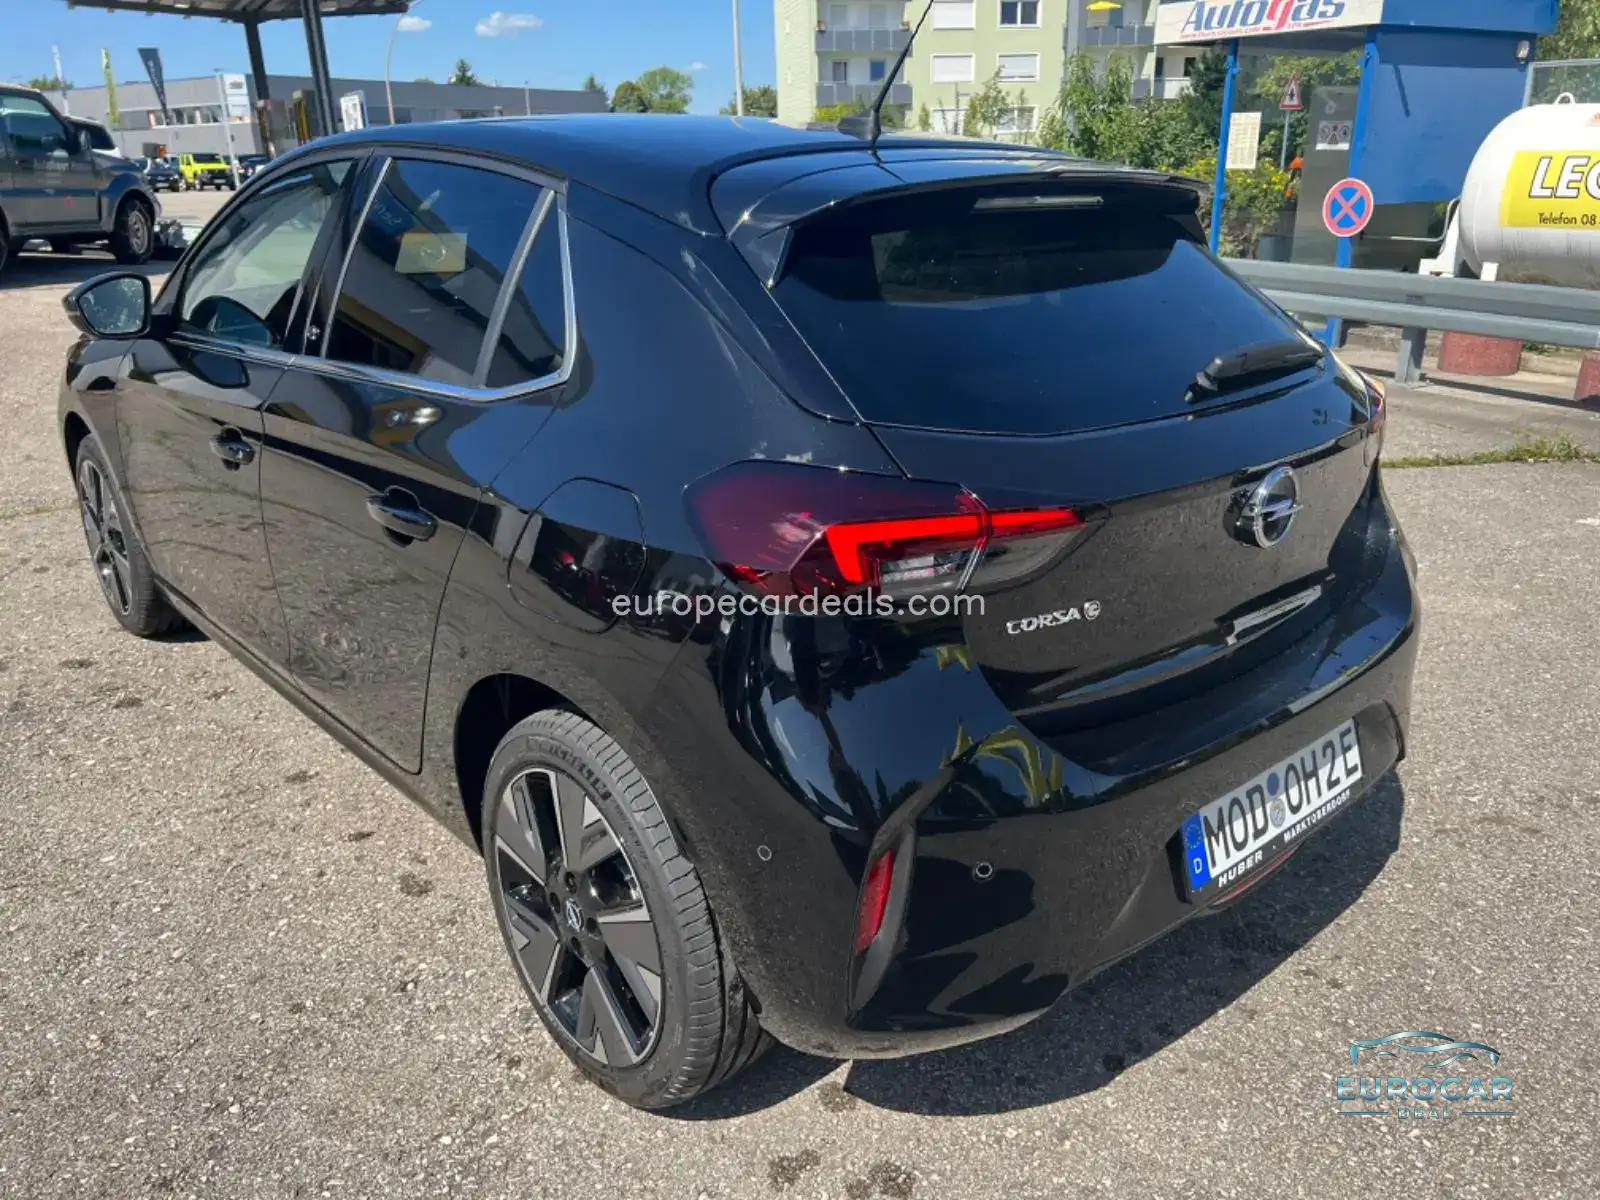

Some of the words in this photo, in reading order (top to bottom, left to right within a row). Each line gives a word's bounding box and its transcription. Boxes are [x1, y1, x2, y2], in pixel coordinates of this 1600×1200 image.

[1538, 212, 1578, 225] Telefon
[1581, 213, 1597, 226] 08
[1006, 607, 1082, 634] CORSA
[1203, 784, 1269, 869] MOD
[1283, 727, 1359, 817] OH2E
[1193, 857, 1203, 874] D
[1218, 850, 1263, 888] HUBER
